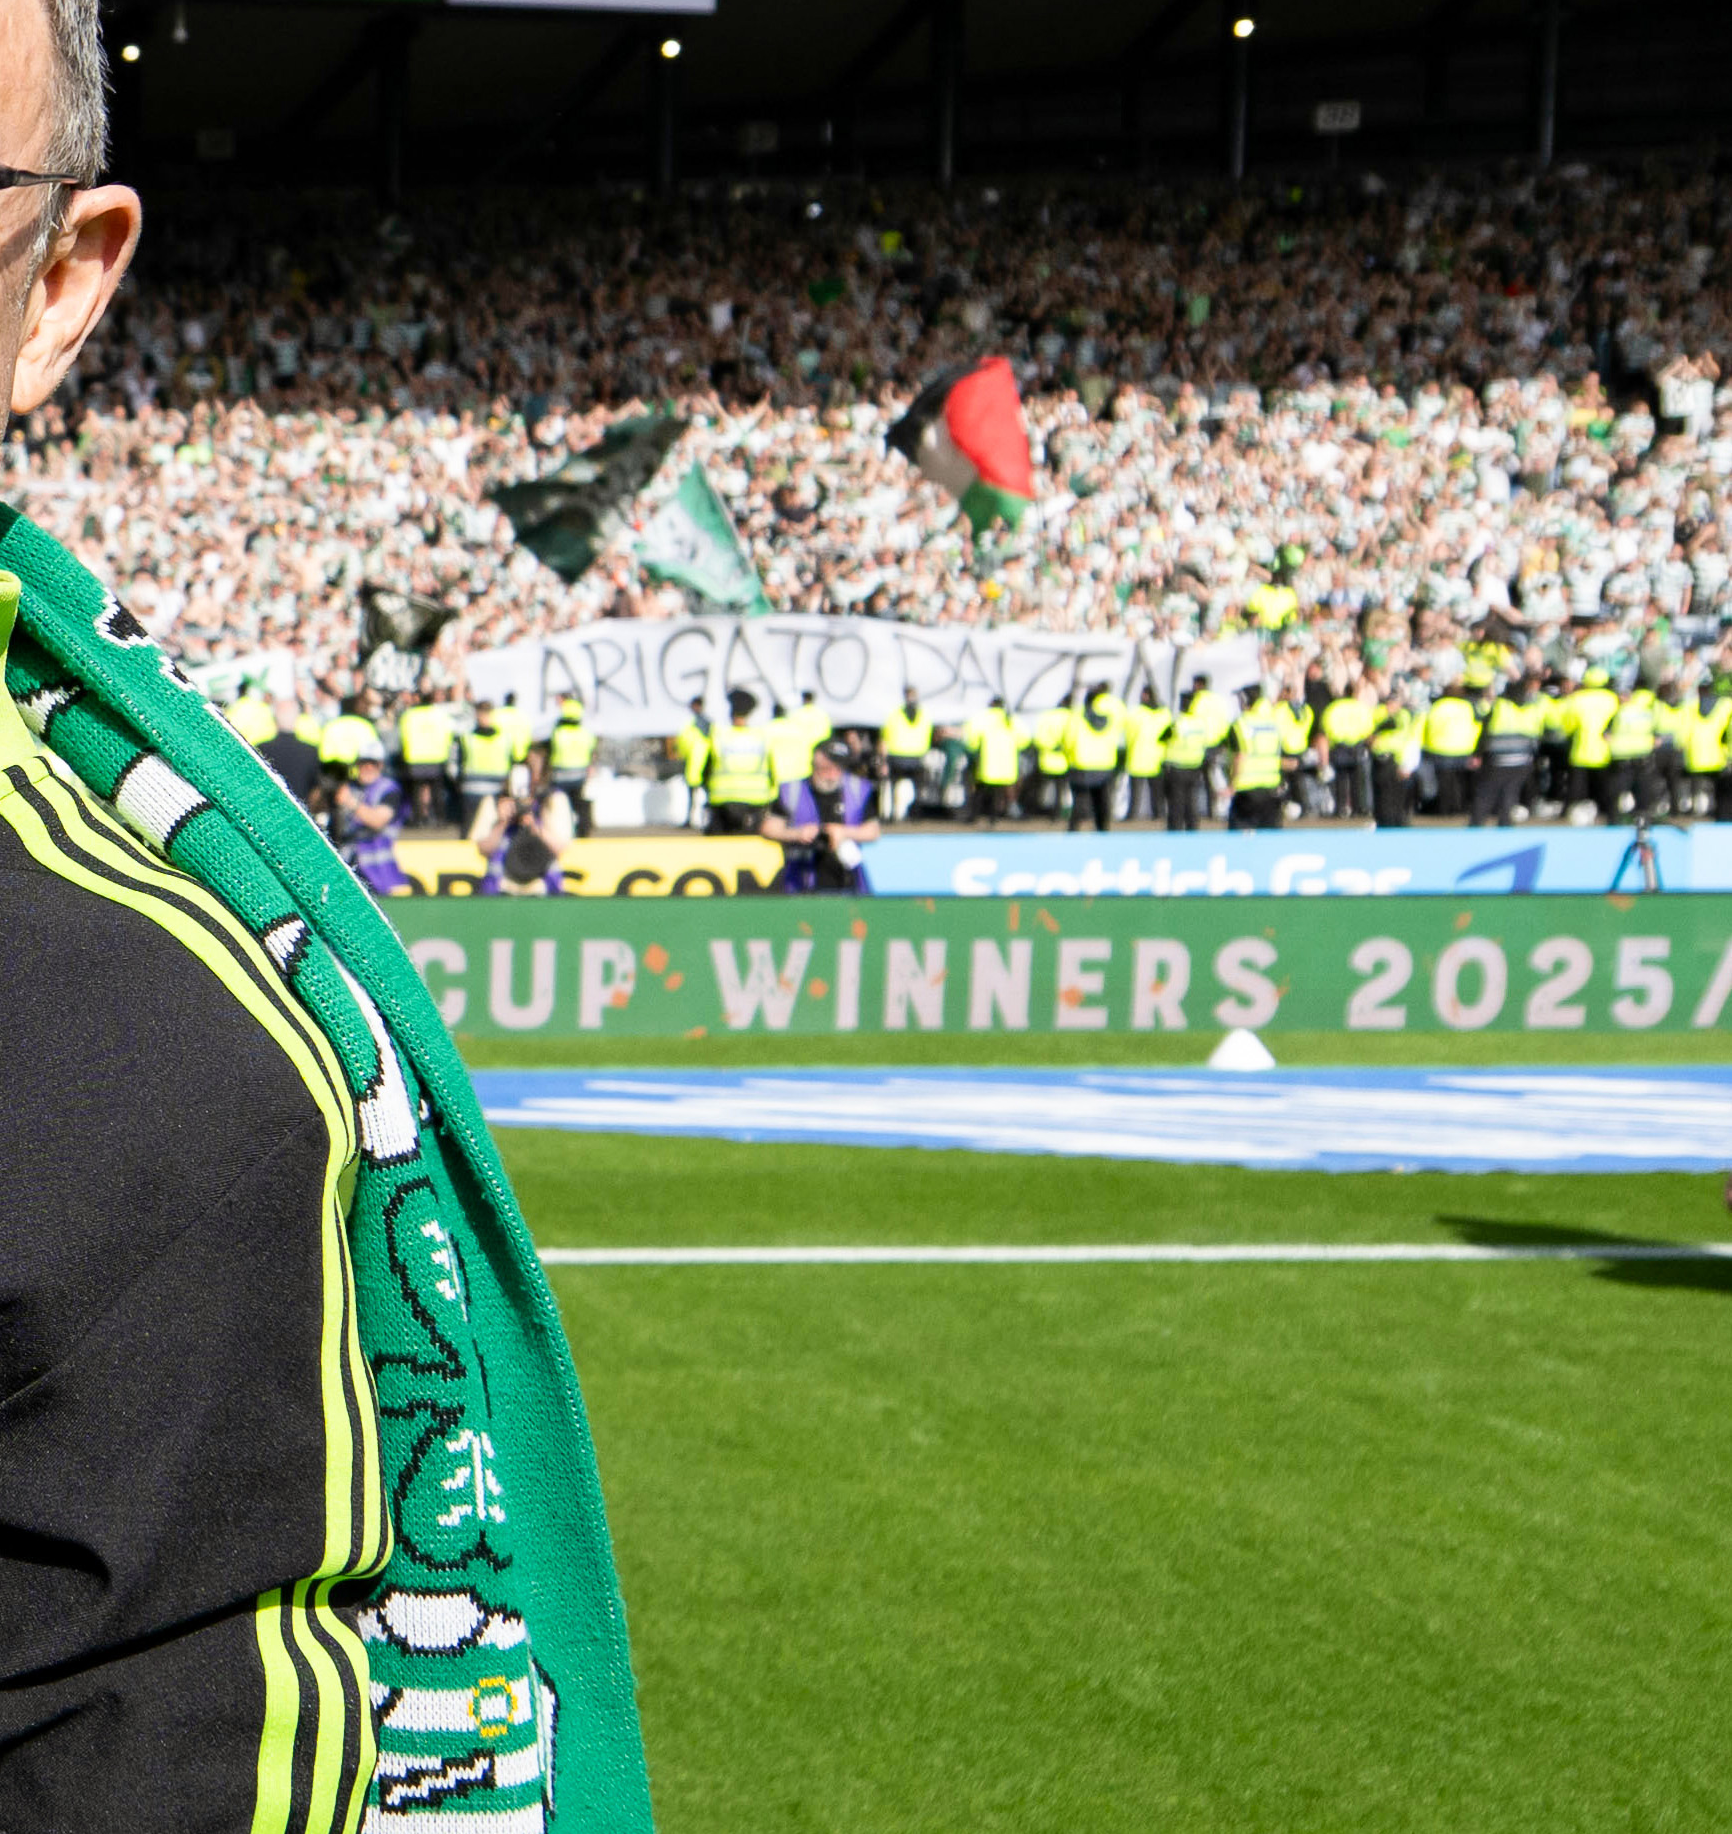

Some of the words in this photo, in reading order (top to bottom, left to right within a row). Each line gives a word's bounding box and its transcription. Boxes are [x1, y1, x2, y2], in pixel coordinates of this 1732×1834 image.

[539, 623, 872, 715] ARIGATO
[409, 936, 635, 1031] CUP
[708, 933, 1282, 1033] WINNERS
